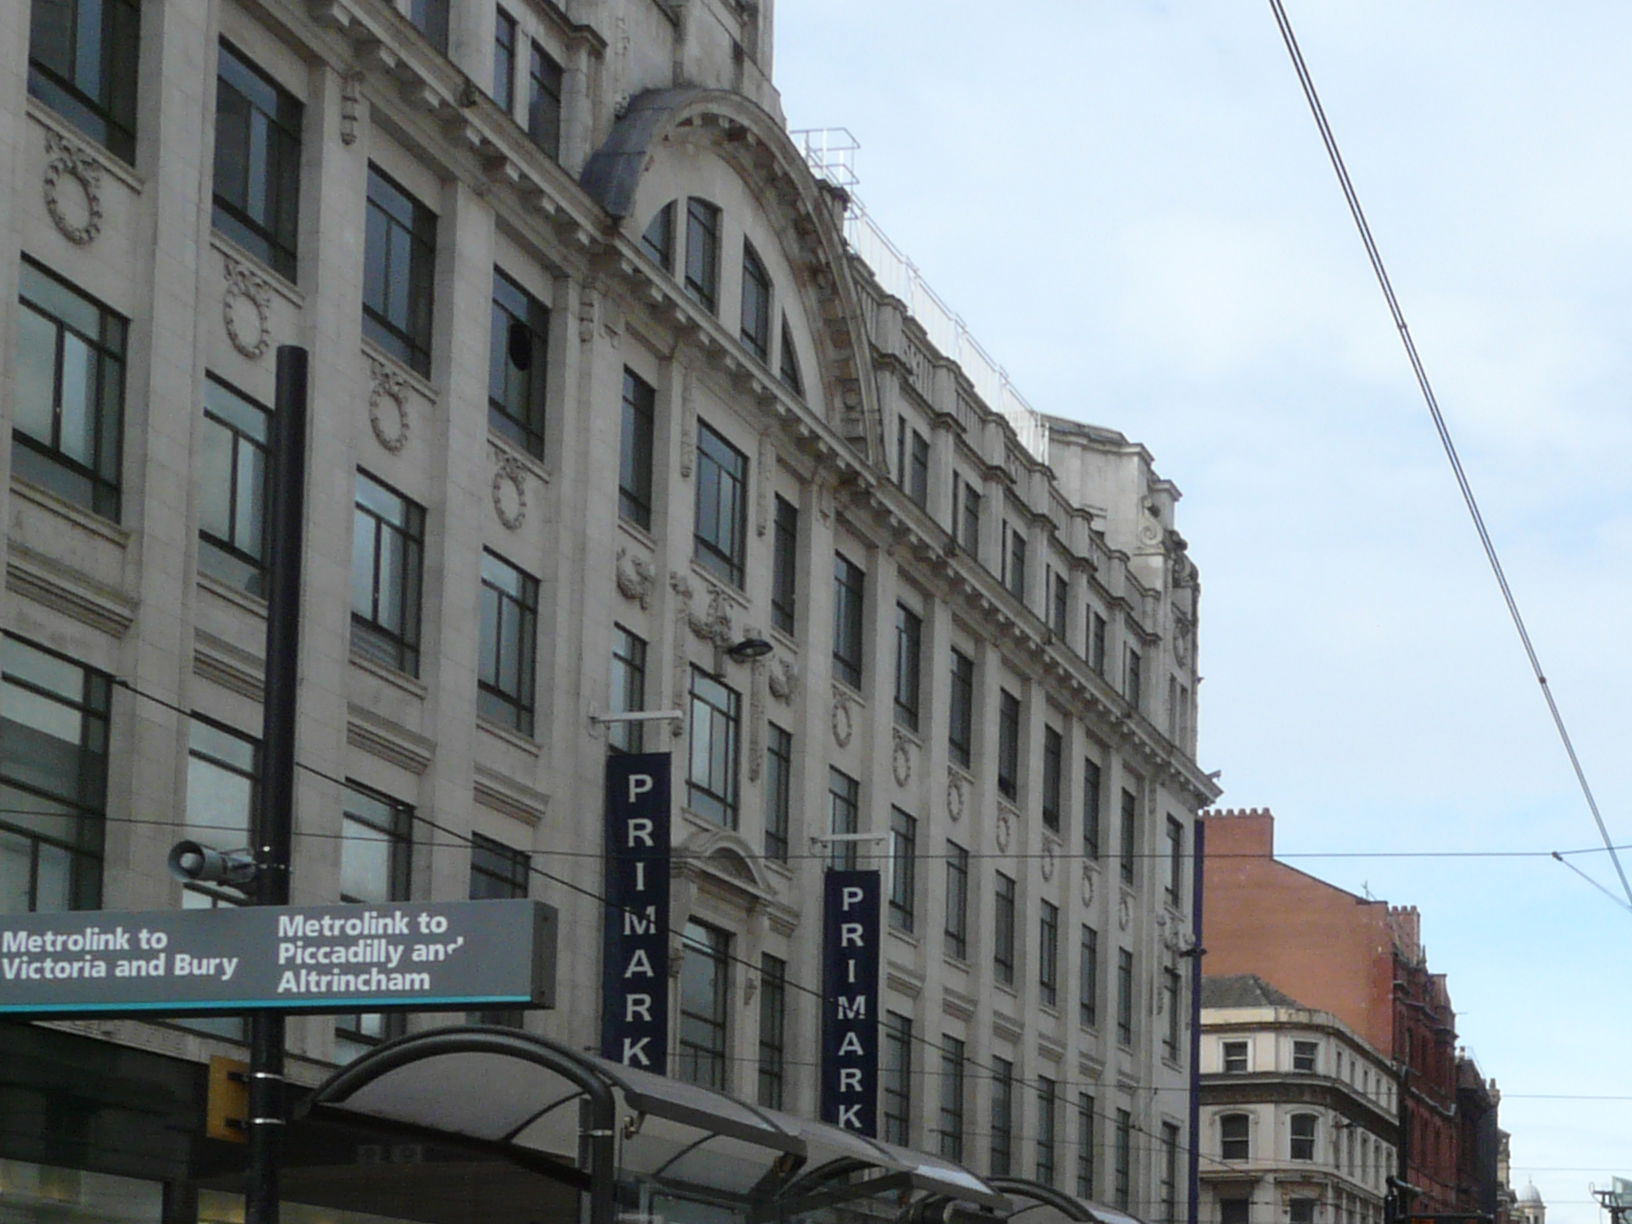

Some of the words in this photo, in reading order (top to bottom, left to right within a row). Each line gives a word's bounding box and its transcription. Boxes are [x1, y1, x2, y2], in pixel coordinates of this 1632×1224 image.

[278, 911, 410, 938] Metrolink
[417, 912, 449, 934] to
[622, 773, 656, 1067] PRIMARK
[1, 927, 131, 953] Metrolink
[138, 928, 168, 950] to
[278, 939, 405, 968] Piccadilly
[1, 956, 108, 980] Victoria
[114, 952, 167, 978] and
[174, 953, 239, 981] Bury
[276, 967, 431, 993] Altrincham
[837, 886, 866, 1130] PRIMARK
